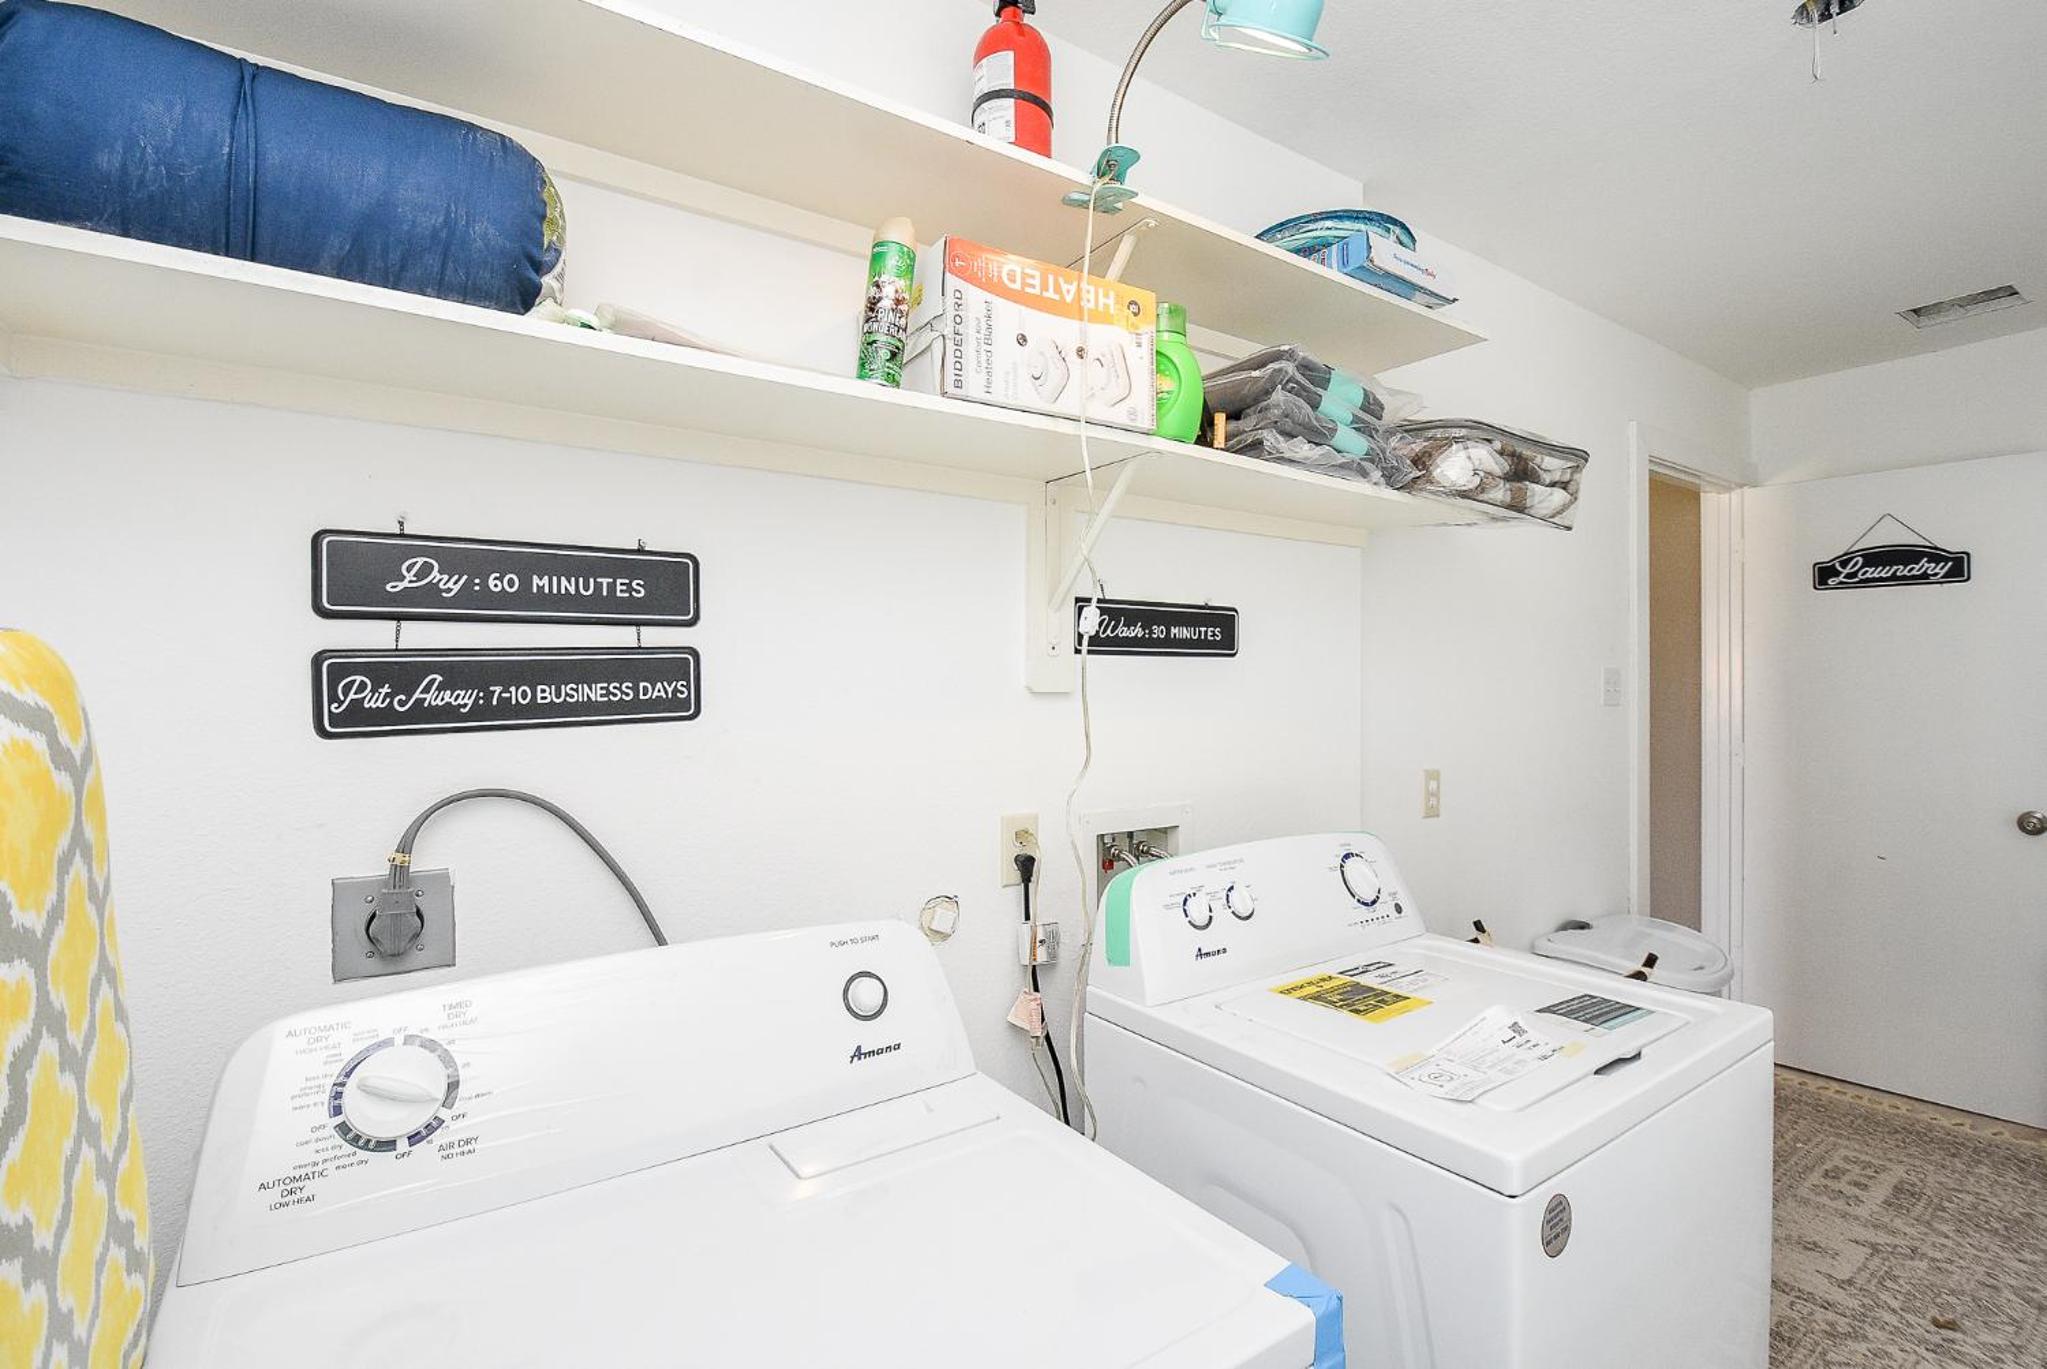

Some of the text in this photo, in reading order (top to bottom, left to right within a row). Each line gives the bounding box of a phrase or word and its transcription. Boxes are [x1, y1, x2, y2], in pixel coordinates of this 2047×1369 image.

[1001, 262, 1115, 314] HEATED
[877, 307, 902, 327] PINE
[953, 288, 963, 390] BIDDEFORD
[983, 299, 993, 395] Heated Blanket
[1827, 556, 1953, 585] Laundry
[488, 572, 519, 593] 60
[532, 575, 646, 598] MINUTES
[1151, 625, 1167, 638] 30
[1170, 626, 1222, 640] MINUTES
[330, 674, 689, 713] Put Away: 7-10 BUSINESS DAYS
[829, 934, 880, 948] PUSH TO START
[1195, 946, 1228, 962] Amana
[285, 1020, 352, 1039] AUTOMATIC
[306, 1034, 331, 1046] DRY
[849, 1041, 902, 1064] Amana
[438, 1141, 456, 1153] AIR
[458, 1135, 480, 1148] DRY
[395, 1150, 413, 1160] OFF
[441, 1151, 454, 1161] NO
[257, 1169, 329, 1192] AUTOMATIC
[280, 1185, 307, 1199] DRY
[269, 1194, 317, 1212] LOW HEAT
